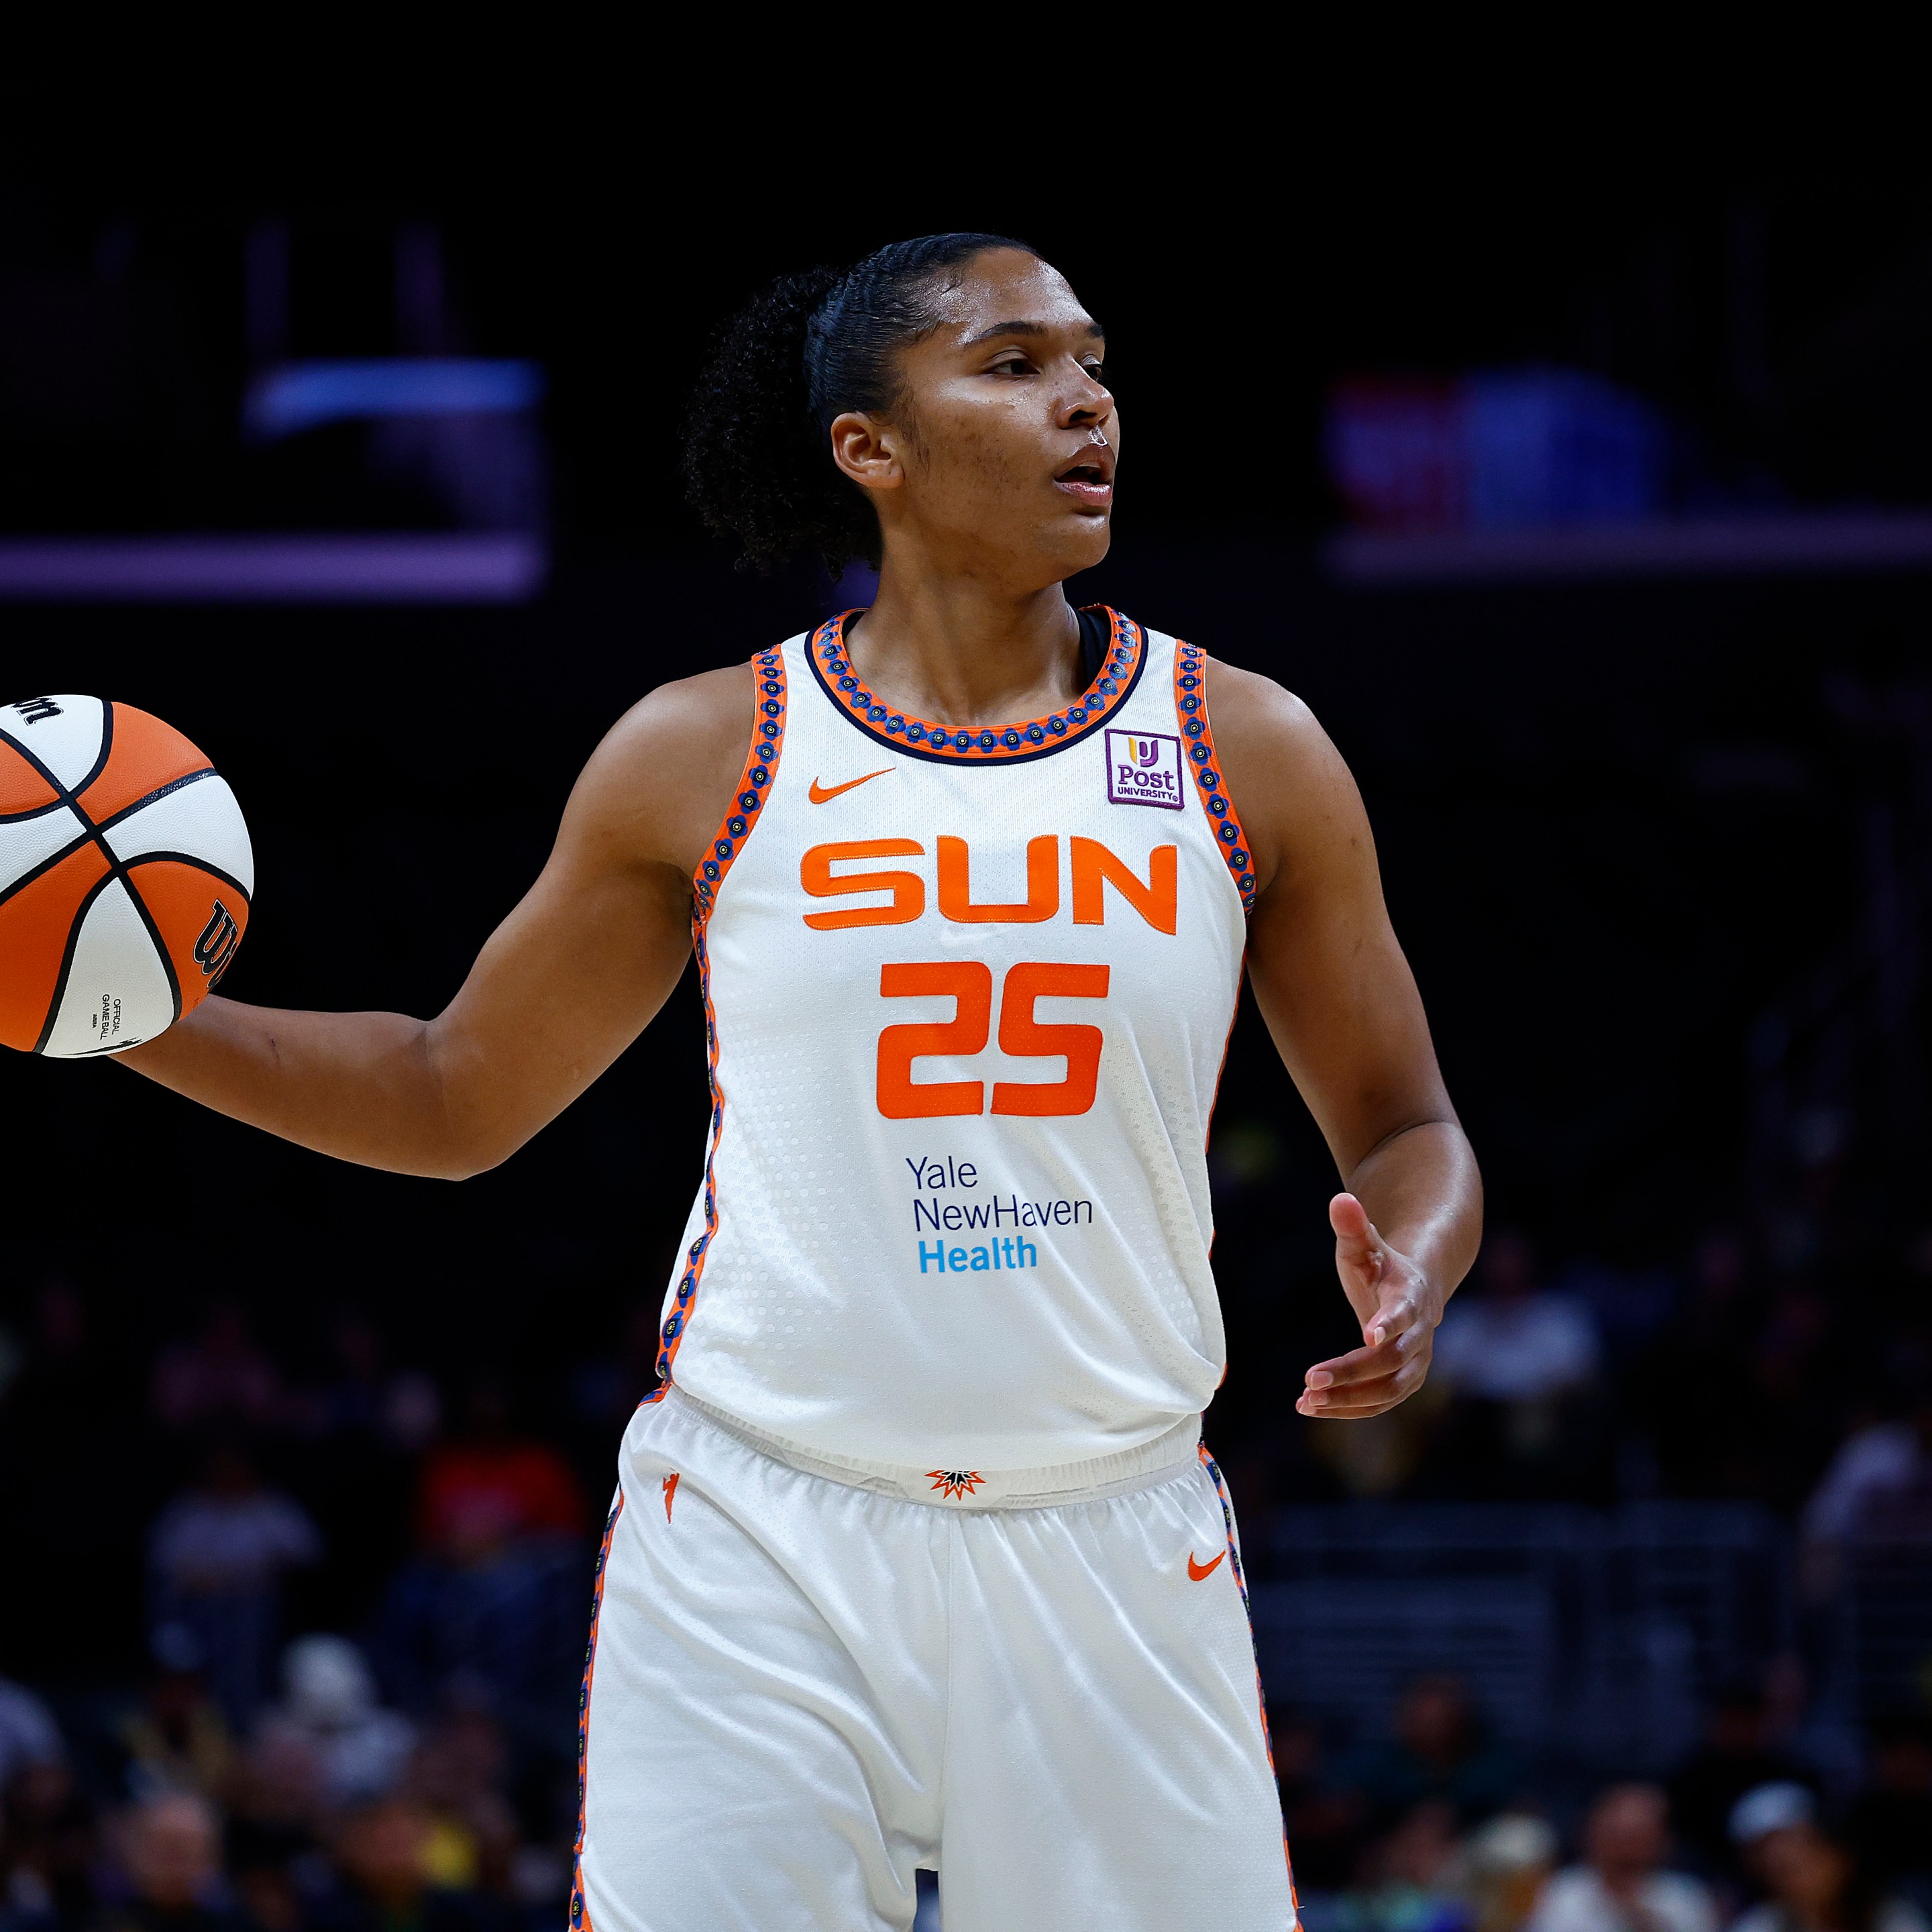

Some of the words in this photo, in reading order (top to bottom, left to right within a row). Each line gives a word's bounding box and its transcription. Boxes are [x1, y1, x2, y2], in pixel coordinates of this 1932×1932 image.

[1117, 764, 1175, 790] Post
[800, 834, 1177, 936] SUN
[102, 994, 110, 1022] GAME
[111, 998, 121, 1034] OFFICIAL
[99, 1022, 109, 1040] BALL
[876, 961, 1110, 1119] 25
[906, 1155, 978, 1190] Yale
[913, 1194, 1092, 1232] NewHaven
[918, 1235, 1037, 1274] Health
